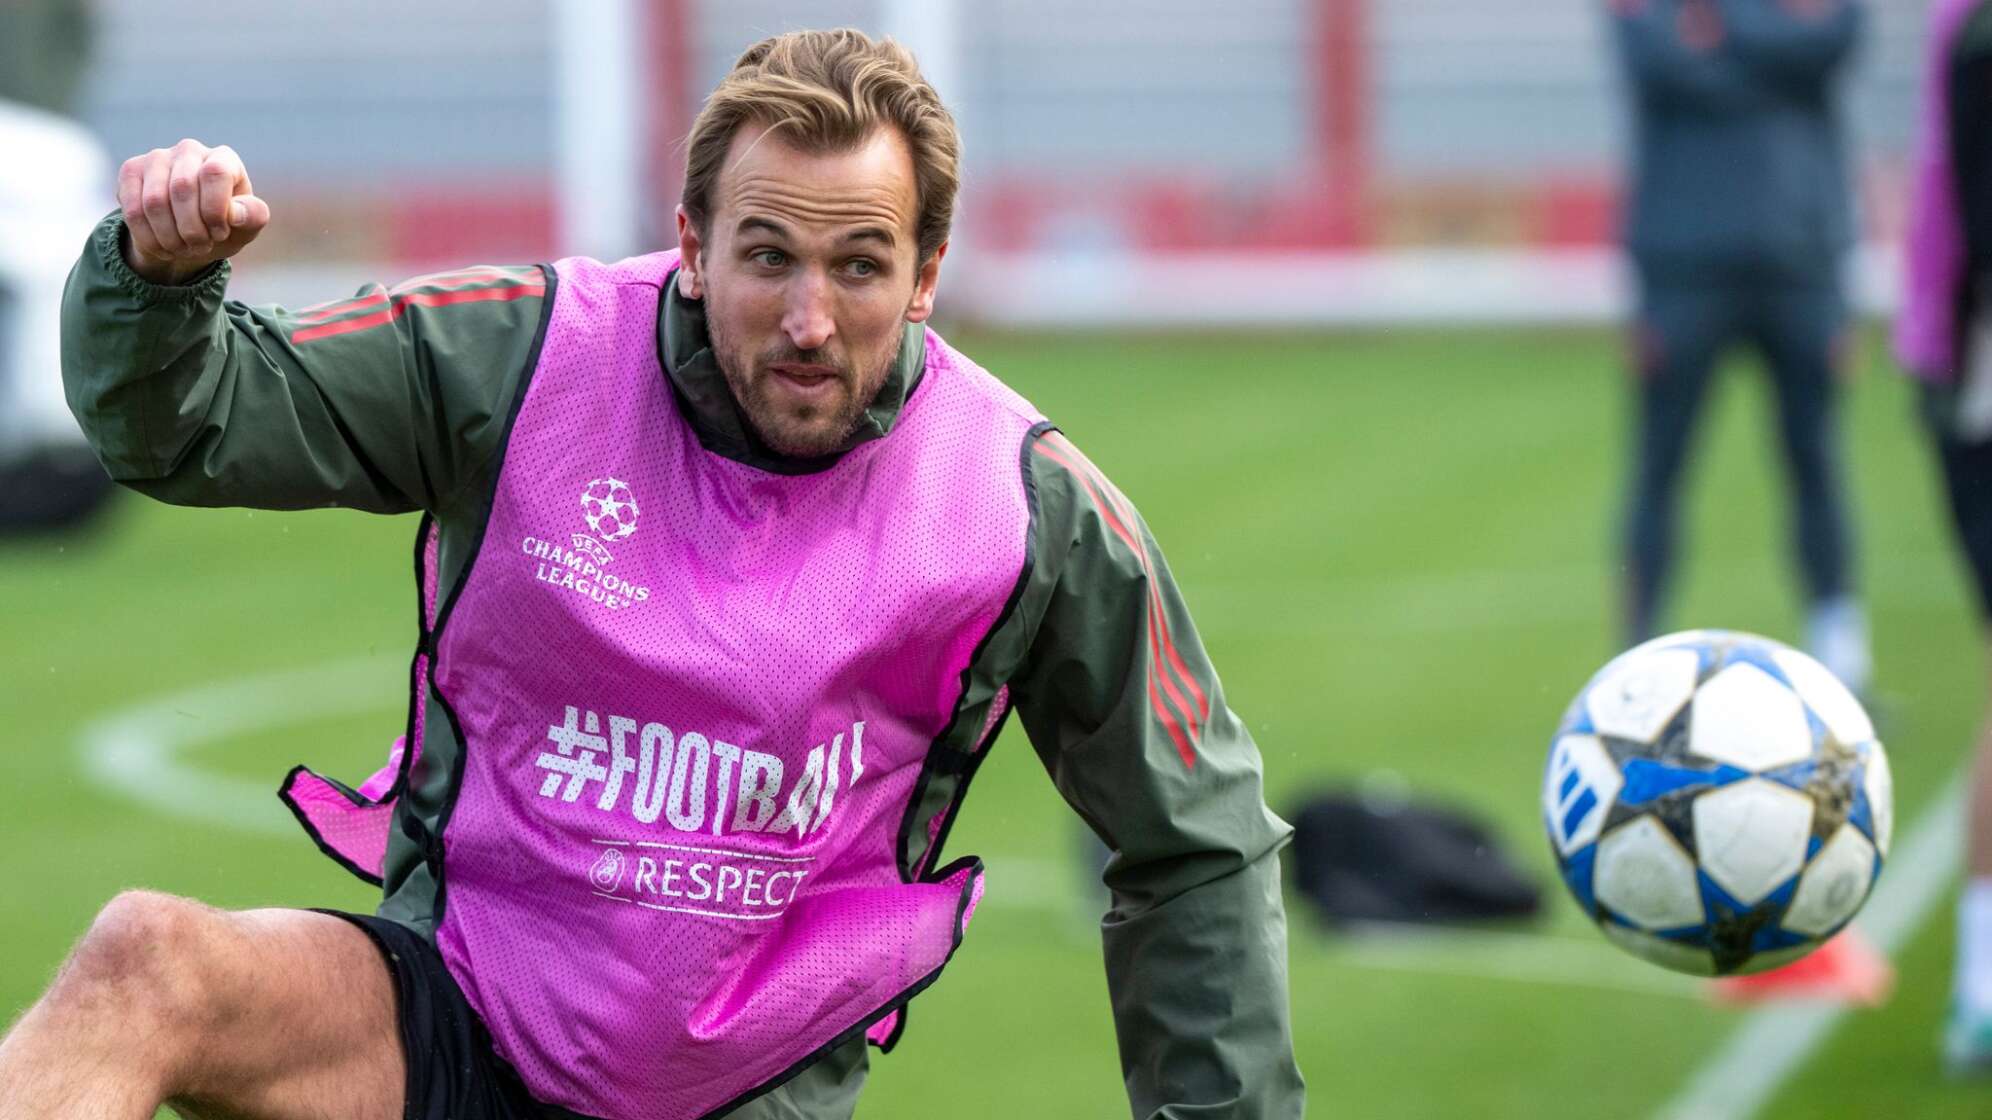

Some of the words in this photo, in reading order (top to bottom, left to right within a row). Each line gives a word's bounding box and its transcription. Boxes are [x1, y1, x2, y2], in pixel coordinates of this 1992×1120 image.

[522, 537, 649, 601] CHAMPIONS
[573, 537, 609, 566] UEFA
[635, 856, 808, 906] RESPECT
